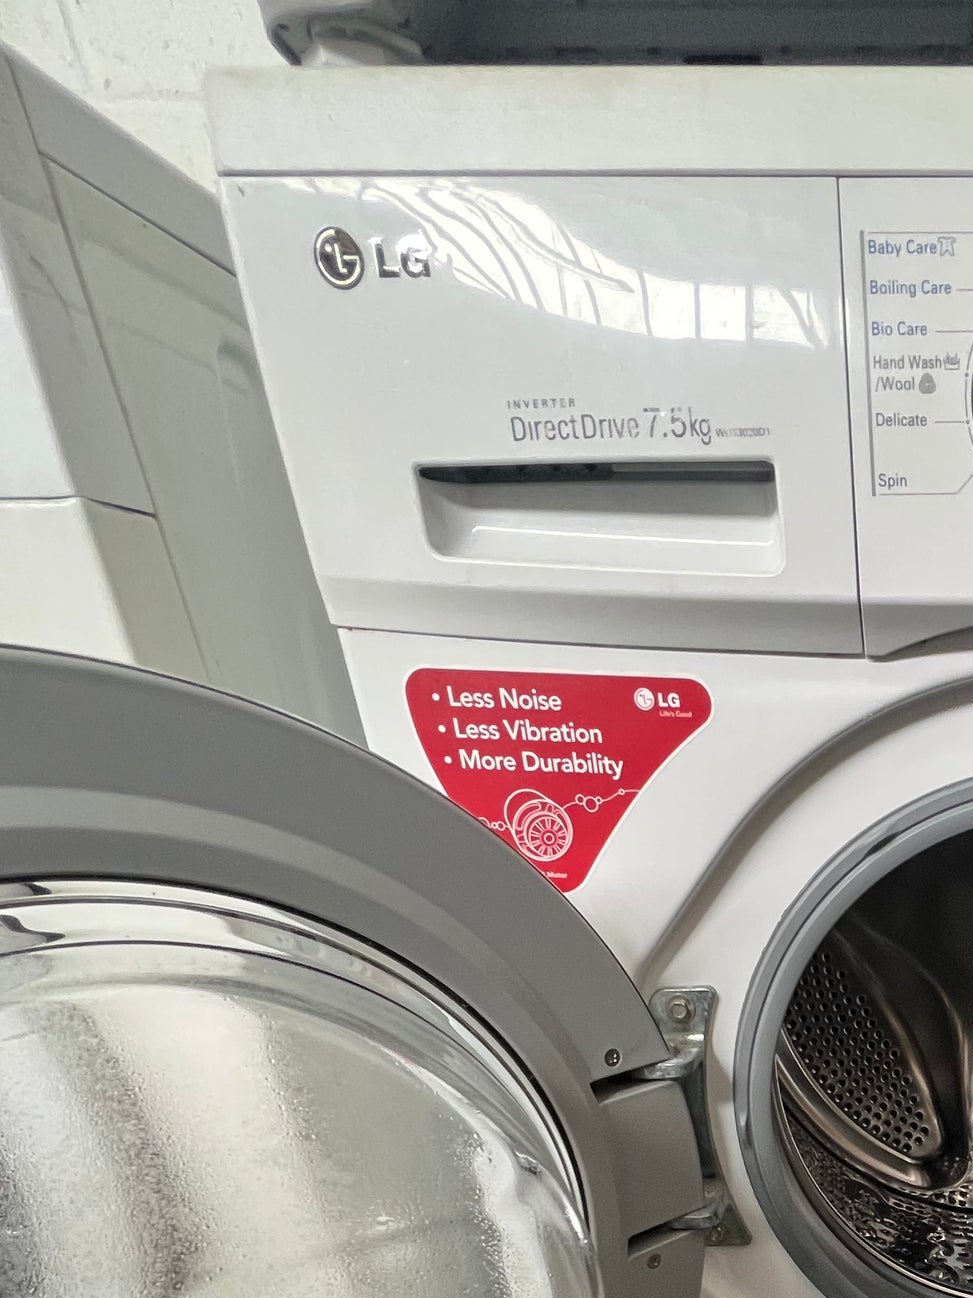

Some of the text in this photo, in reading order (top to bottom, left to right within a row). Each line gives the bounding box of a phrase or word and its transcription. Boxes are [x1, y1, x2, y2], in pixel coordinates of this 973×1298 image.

[369, 236, 431, 278] LG
[868, 240, 937, 257] Baby Care
[870, 279, 951, 297] Boiling Care
[871, 321, 928, 336] Bio Care
[873, 354, 942, 369] Hand Wash
[875, 377, 915, 392] /Wool
[507, 398, 576, 410] INVERTER
[876, 412, 928, 427] Delicate
[878, 473, 907, 490] Spin
[446, 685, 562, 711] Less Noise
[657, 692, 680, 708] LG
[453, 718, 603, 744] Less Vibration
[459, 749, 624, 780] More Durability
